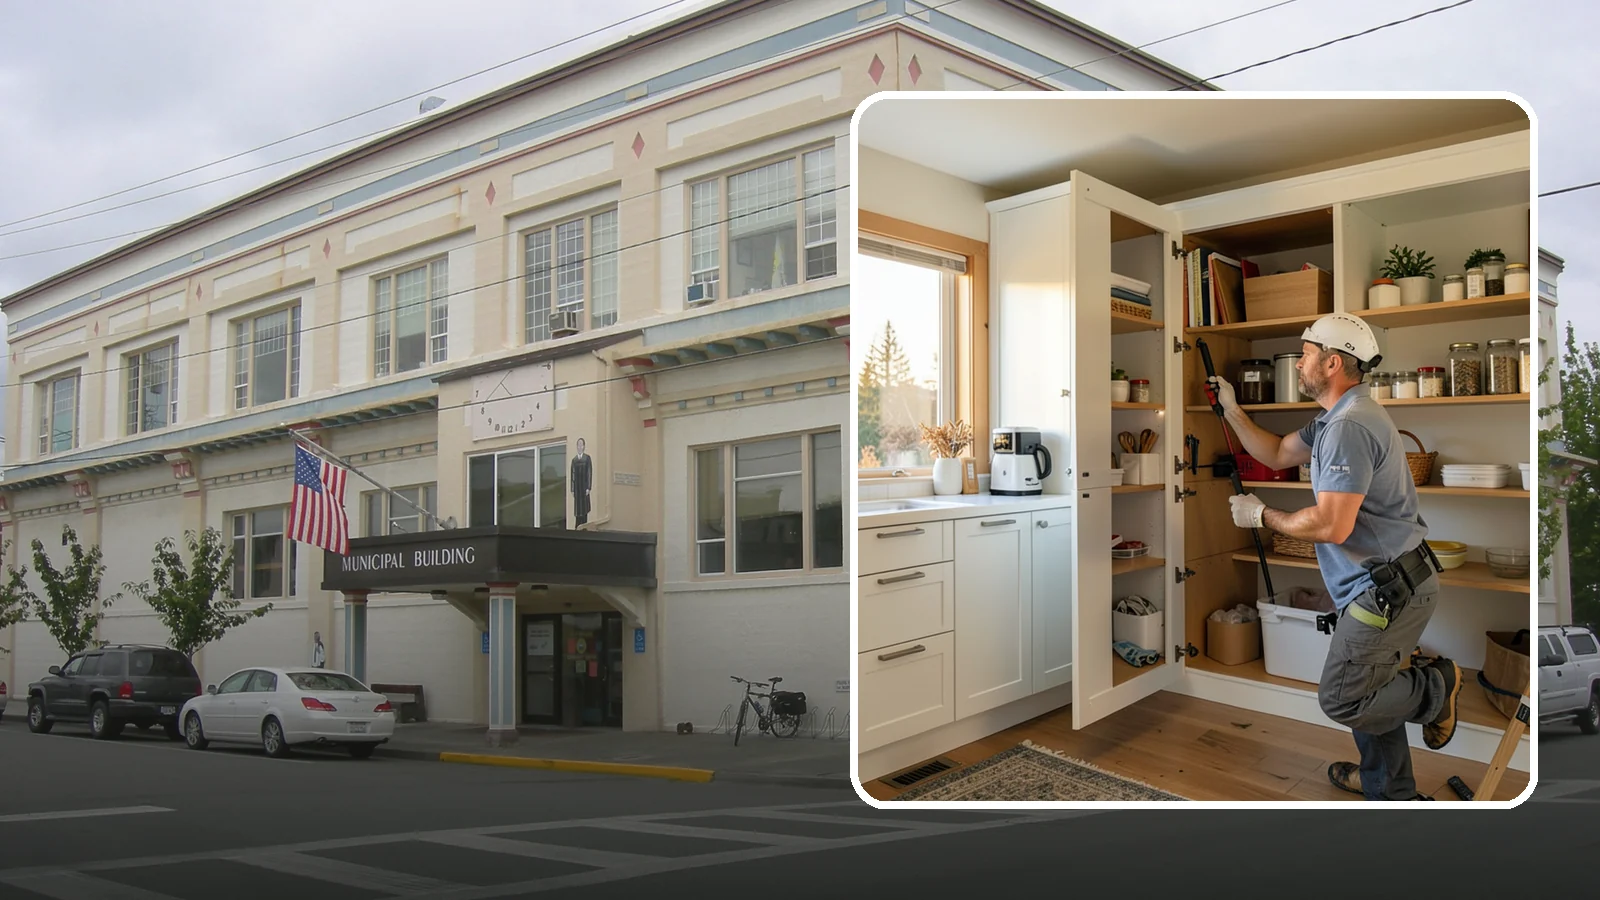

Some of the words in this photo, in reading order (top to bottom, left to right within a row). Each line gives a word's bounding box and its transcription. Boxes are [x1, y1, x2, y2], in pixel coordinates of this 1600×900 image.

[487, 417, 492, 426] 9
[494, 423, 500, 432] 10
[507, 425, 513, 433] 12
[342, 552, 405, 571] MUNICIPAL
[414, 546, 475, 567] BUILDING
